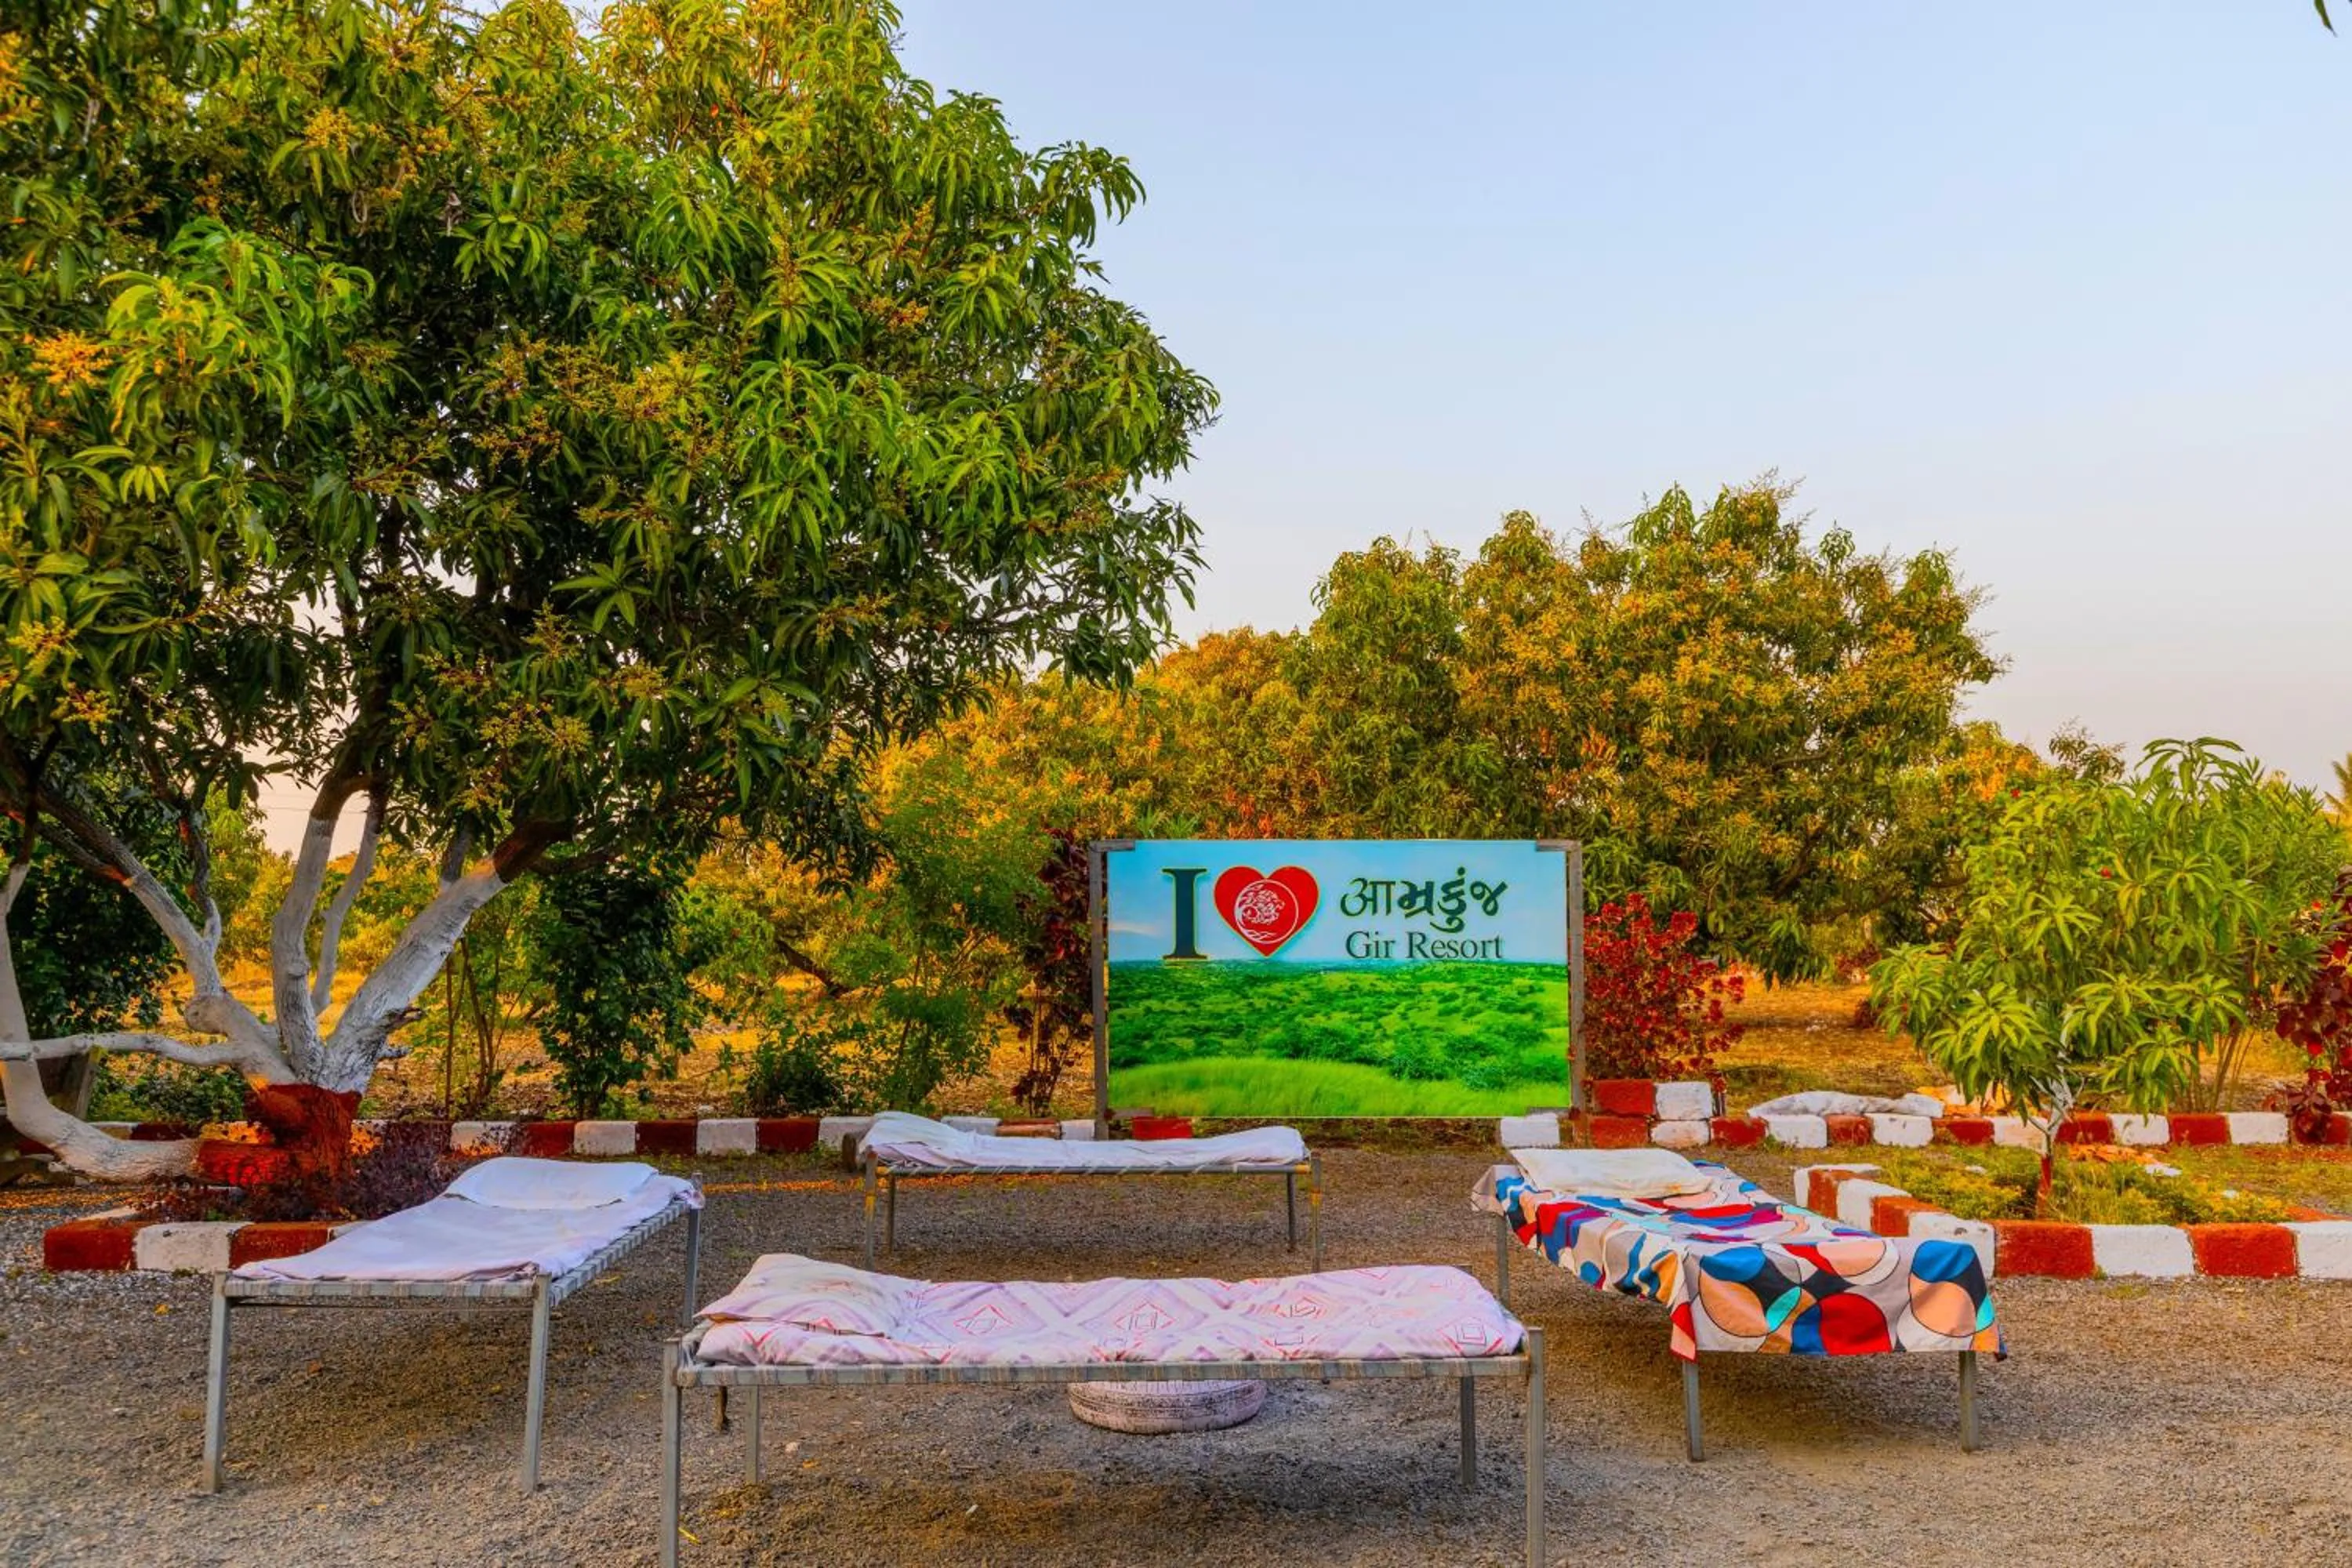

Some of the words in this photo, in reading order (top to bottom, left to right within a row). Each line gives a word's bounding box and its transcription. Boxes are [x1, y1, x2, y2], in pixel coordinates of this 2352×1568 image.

[1161, 868, 1208, 960] I
[1345, 931, 1396, 959] Gir
[1406, 931, 1504, 959] Resort
